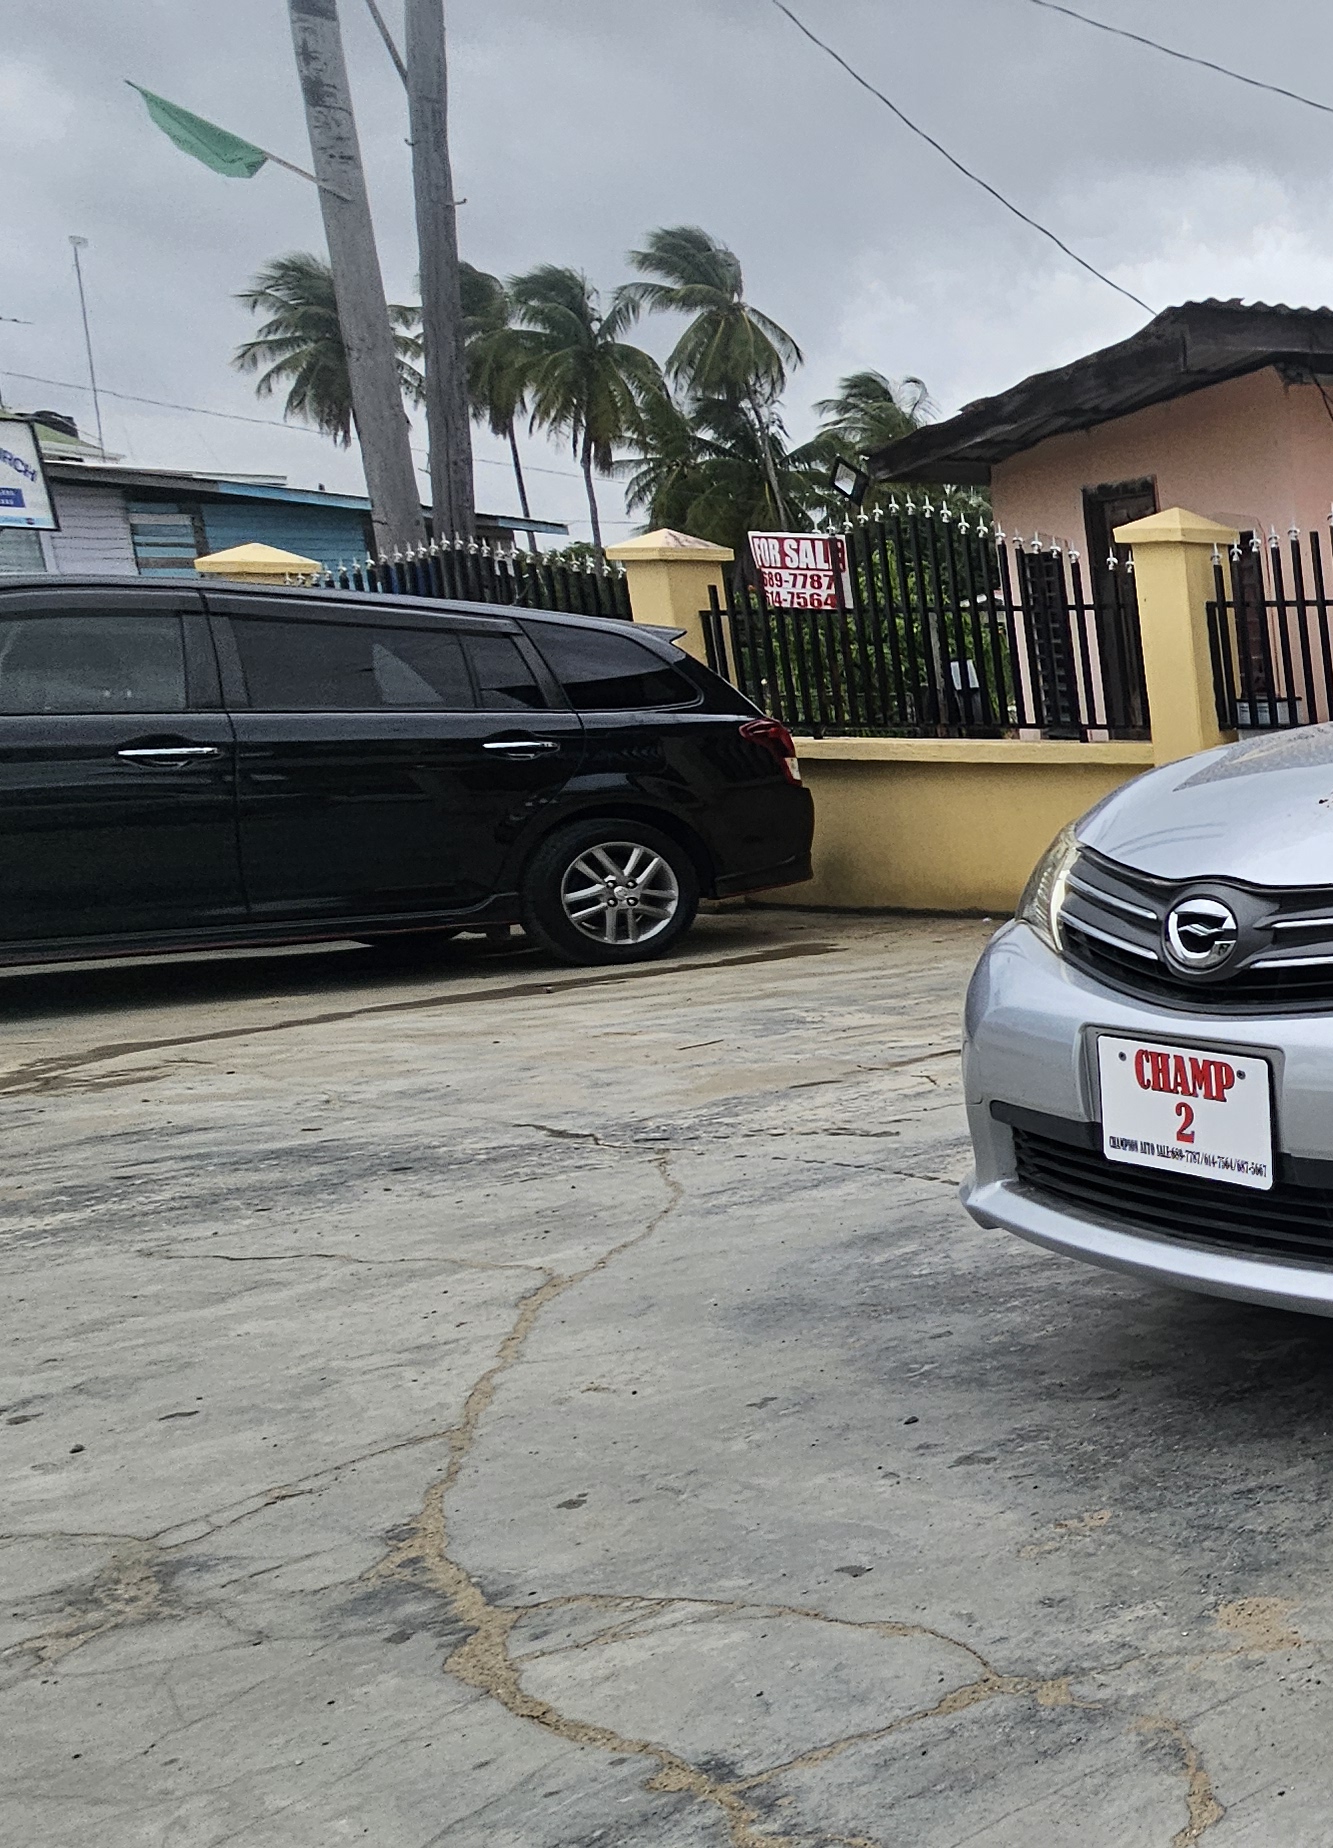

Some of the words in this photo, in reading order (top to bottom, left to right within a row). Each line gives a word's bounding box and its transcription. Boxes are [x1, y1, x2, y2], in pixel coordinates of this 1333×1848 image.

[752, 537, 781, 567] FOR
[1134, 1049, 1235, 1102] CHAMP
[1175, 1102, 1195, 1143] 2
